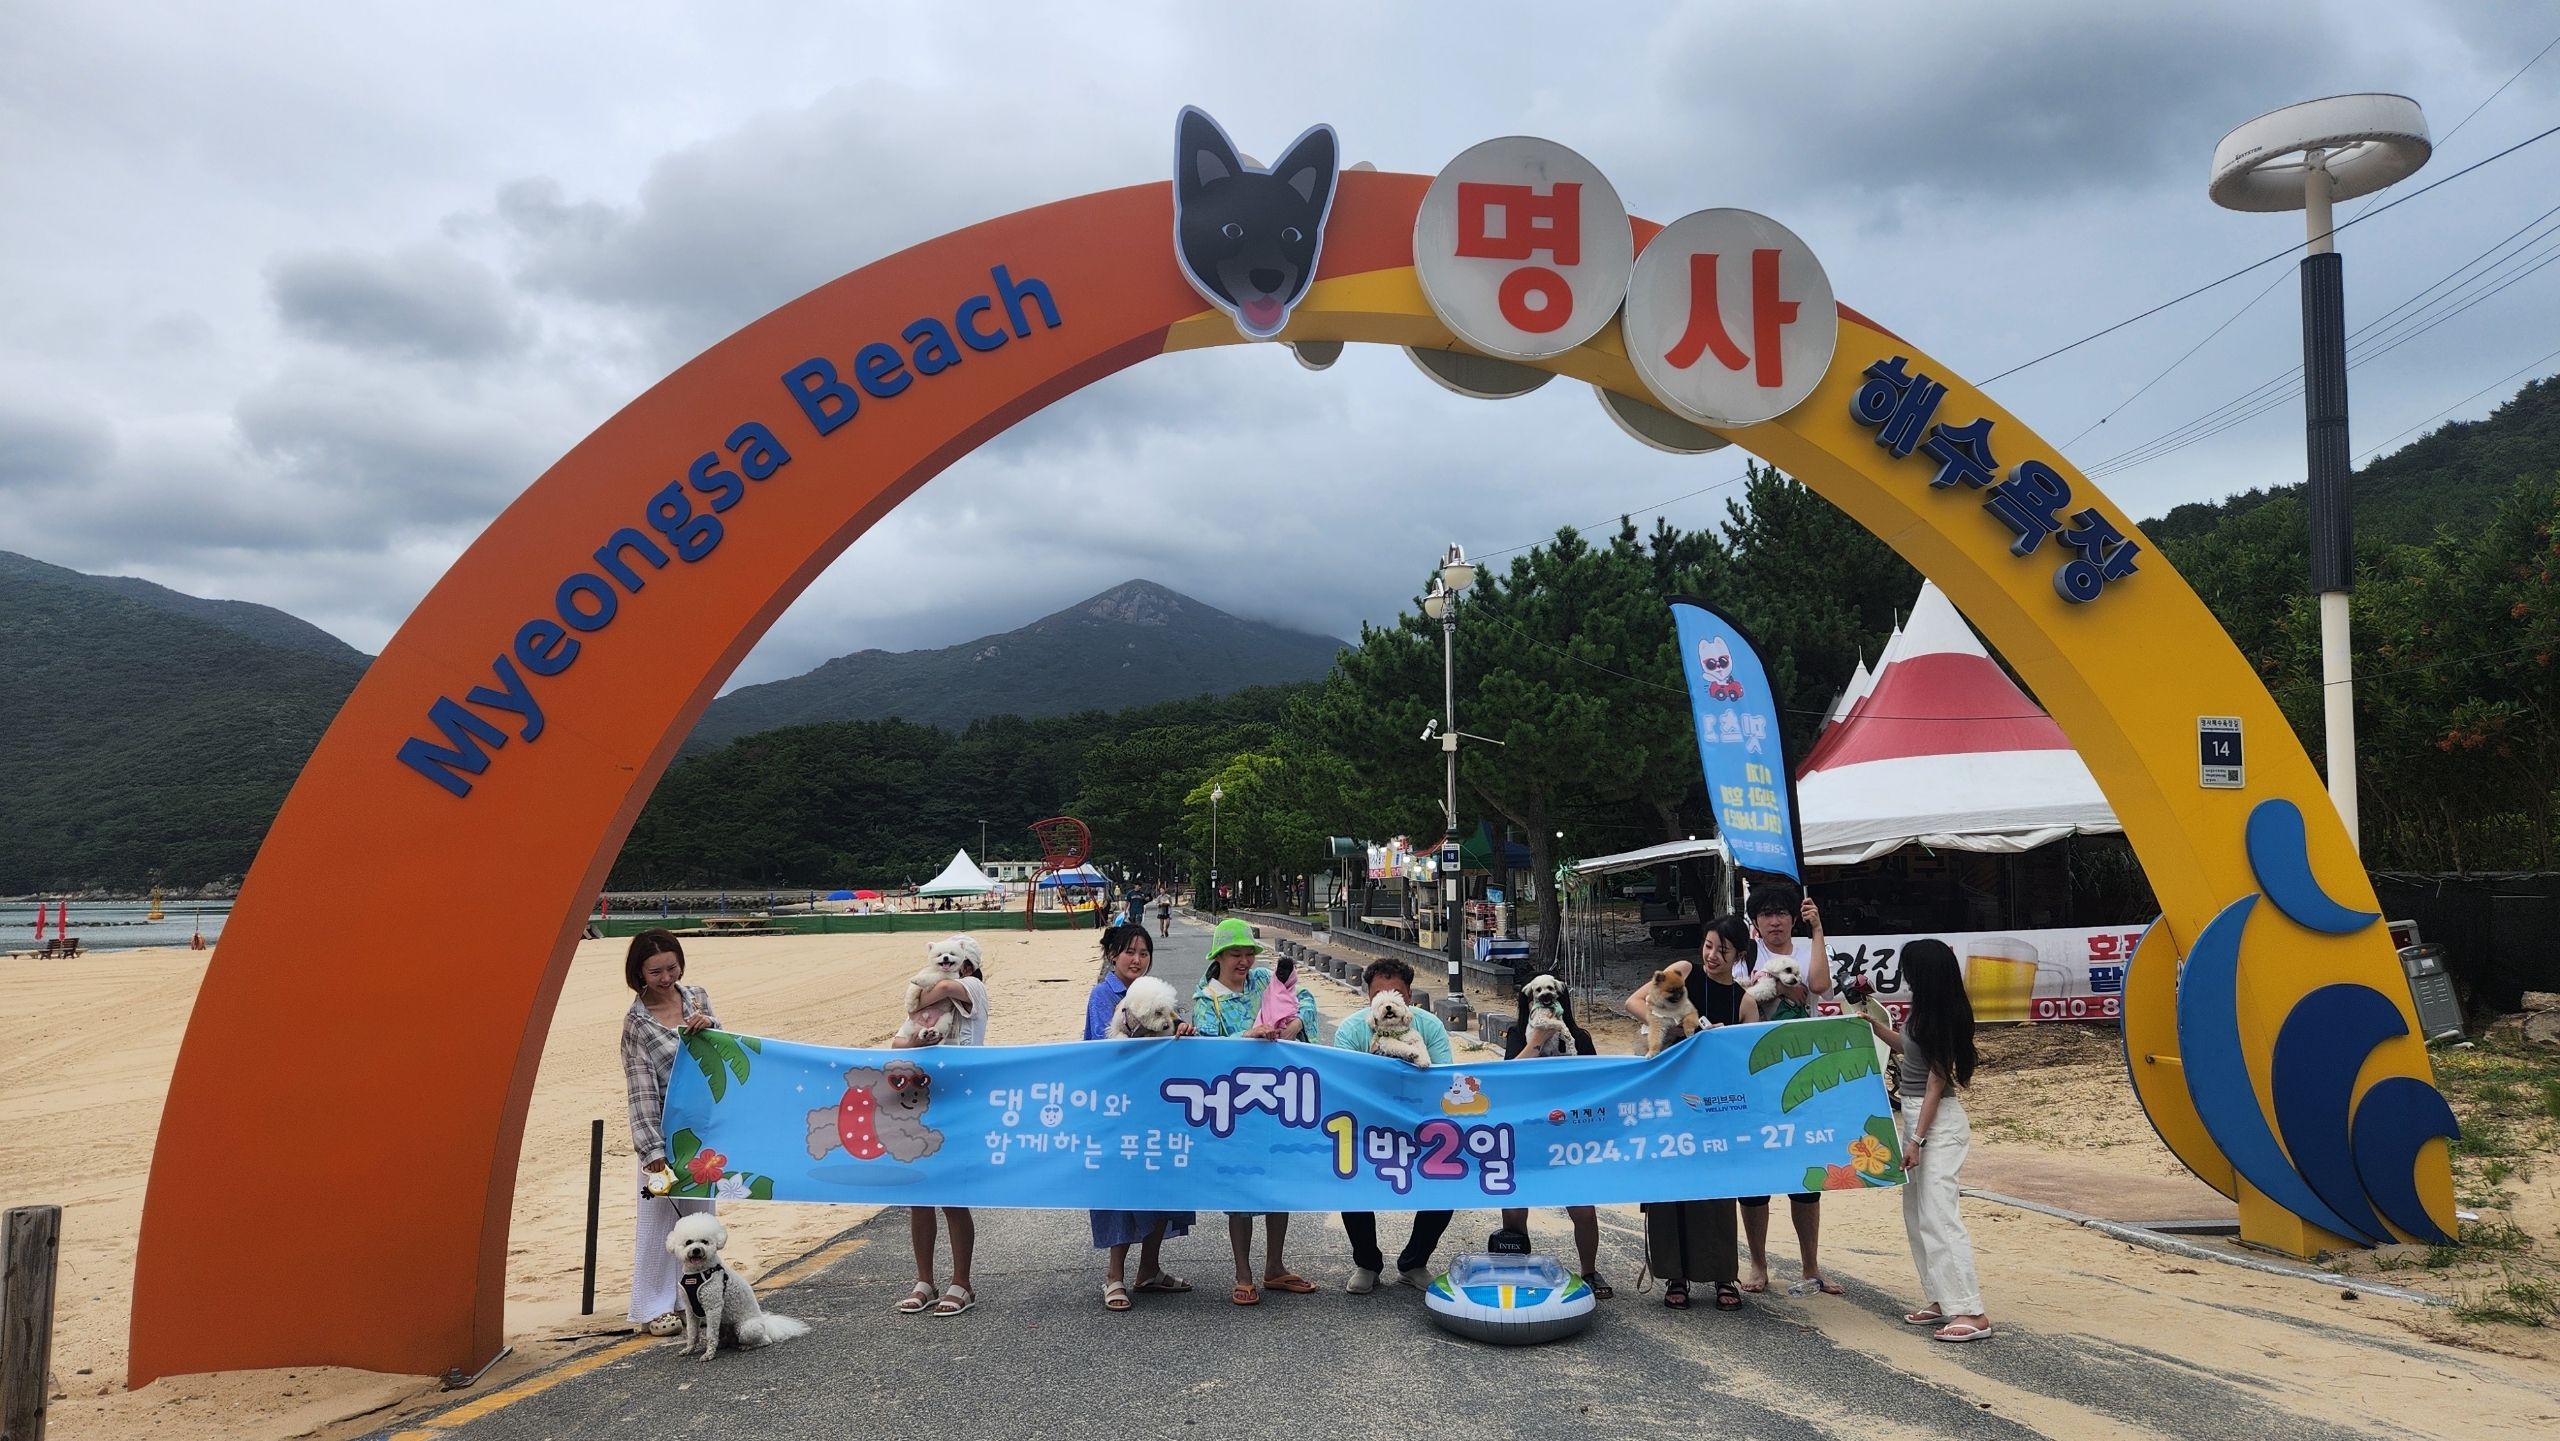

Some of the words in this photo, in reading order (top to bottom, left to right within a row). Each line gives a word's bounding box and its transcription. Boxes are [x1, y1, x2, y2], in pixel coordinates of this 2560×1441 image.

[1454, 180, 1800, 388] 명사
[1849, 355, 2141, 604] 해수욕장
[396, 421, 792, 798] Myeongsa
[780, 263, 1062, 437] Beach
[2212, 740, 2230, 757] 14
[989, 1082, 1132, 1127] 댕댕이와
[1162, 1067, 1319, 1136] 거제
[1570, 1107, 1606, 1118] 거제시
[1617, 1098, 1673, 1126] 펫츠고
[985, 1131, 1102, 1169] 함께하는
[1120, 1129, 1194, 1170] 푸른밤
[1324, 1113, 1514, 1193] 1박2일
[1548, 1132, 1697, 1167] 2024.7.26
[1702, 1138, 1728, 1153] FRI
[1760, 1123, 1796, 1149] 27
[1805, 1128, 1835, 1144] SAT
